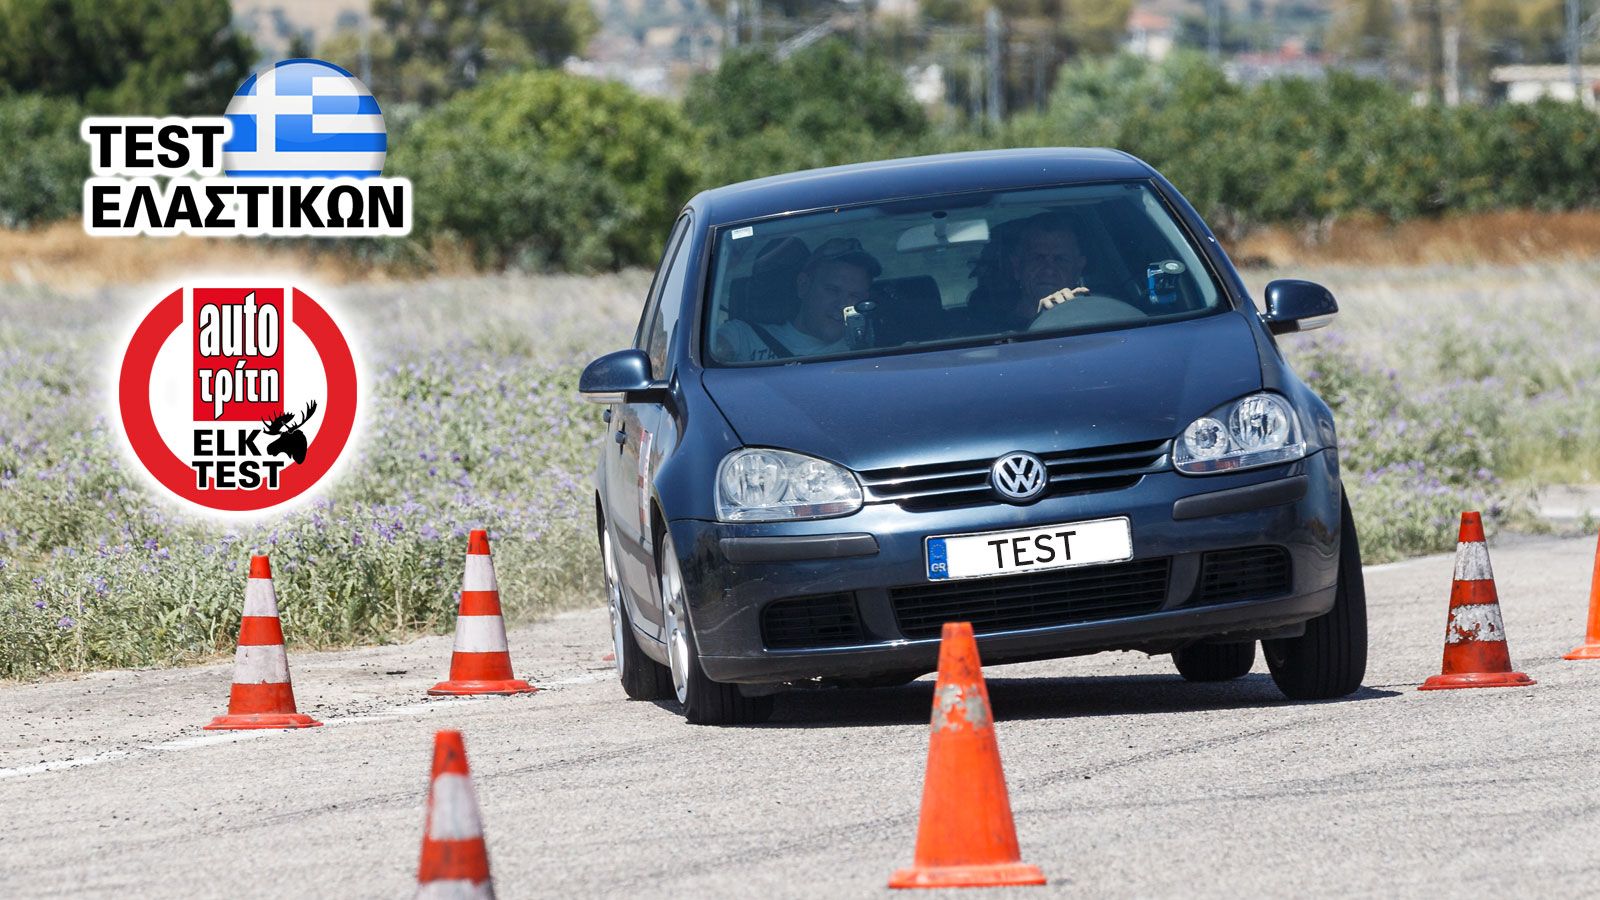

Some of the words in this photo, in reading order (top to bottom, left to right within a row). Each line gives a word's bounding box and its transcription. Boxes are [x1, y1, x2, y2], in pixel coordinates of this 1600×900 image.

[993, 453, 1046, 498] VW
[931, 562, 946, 572] GR
[988, 530, 1076, 568] TEST
